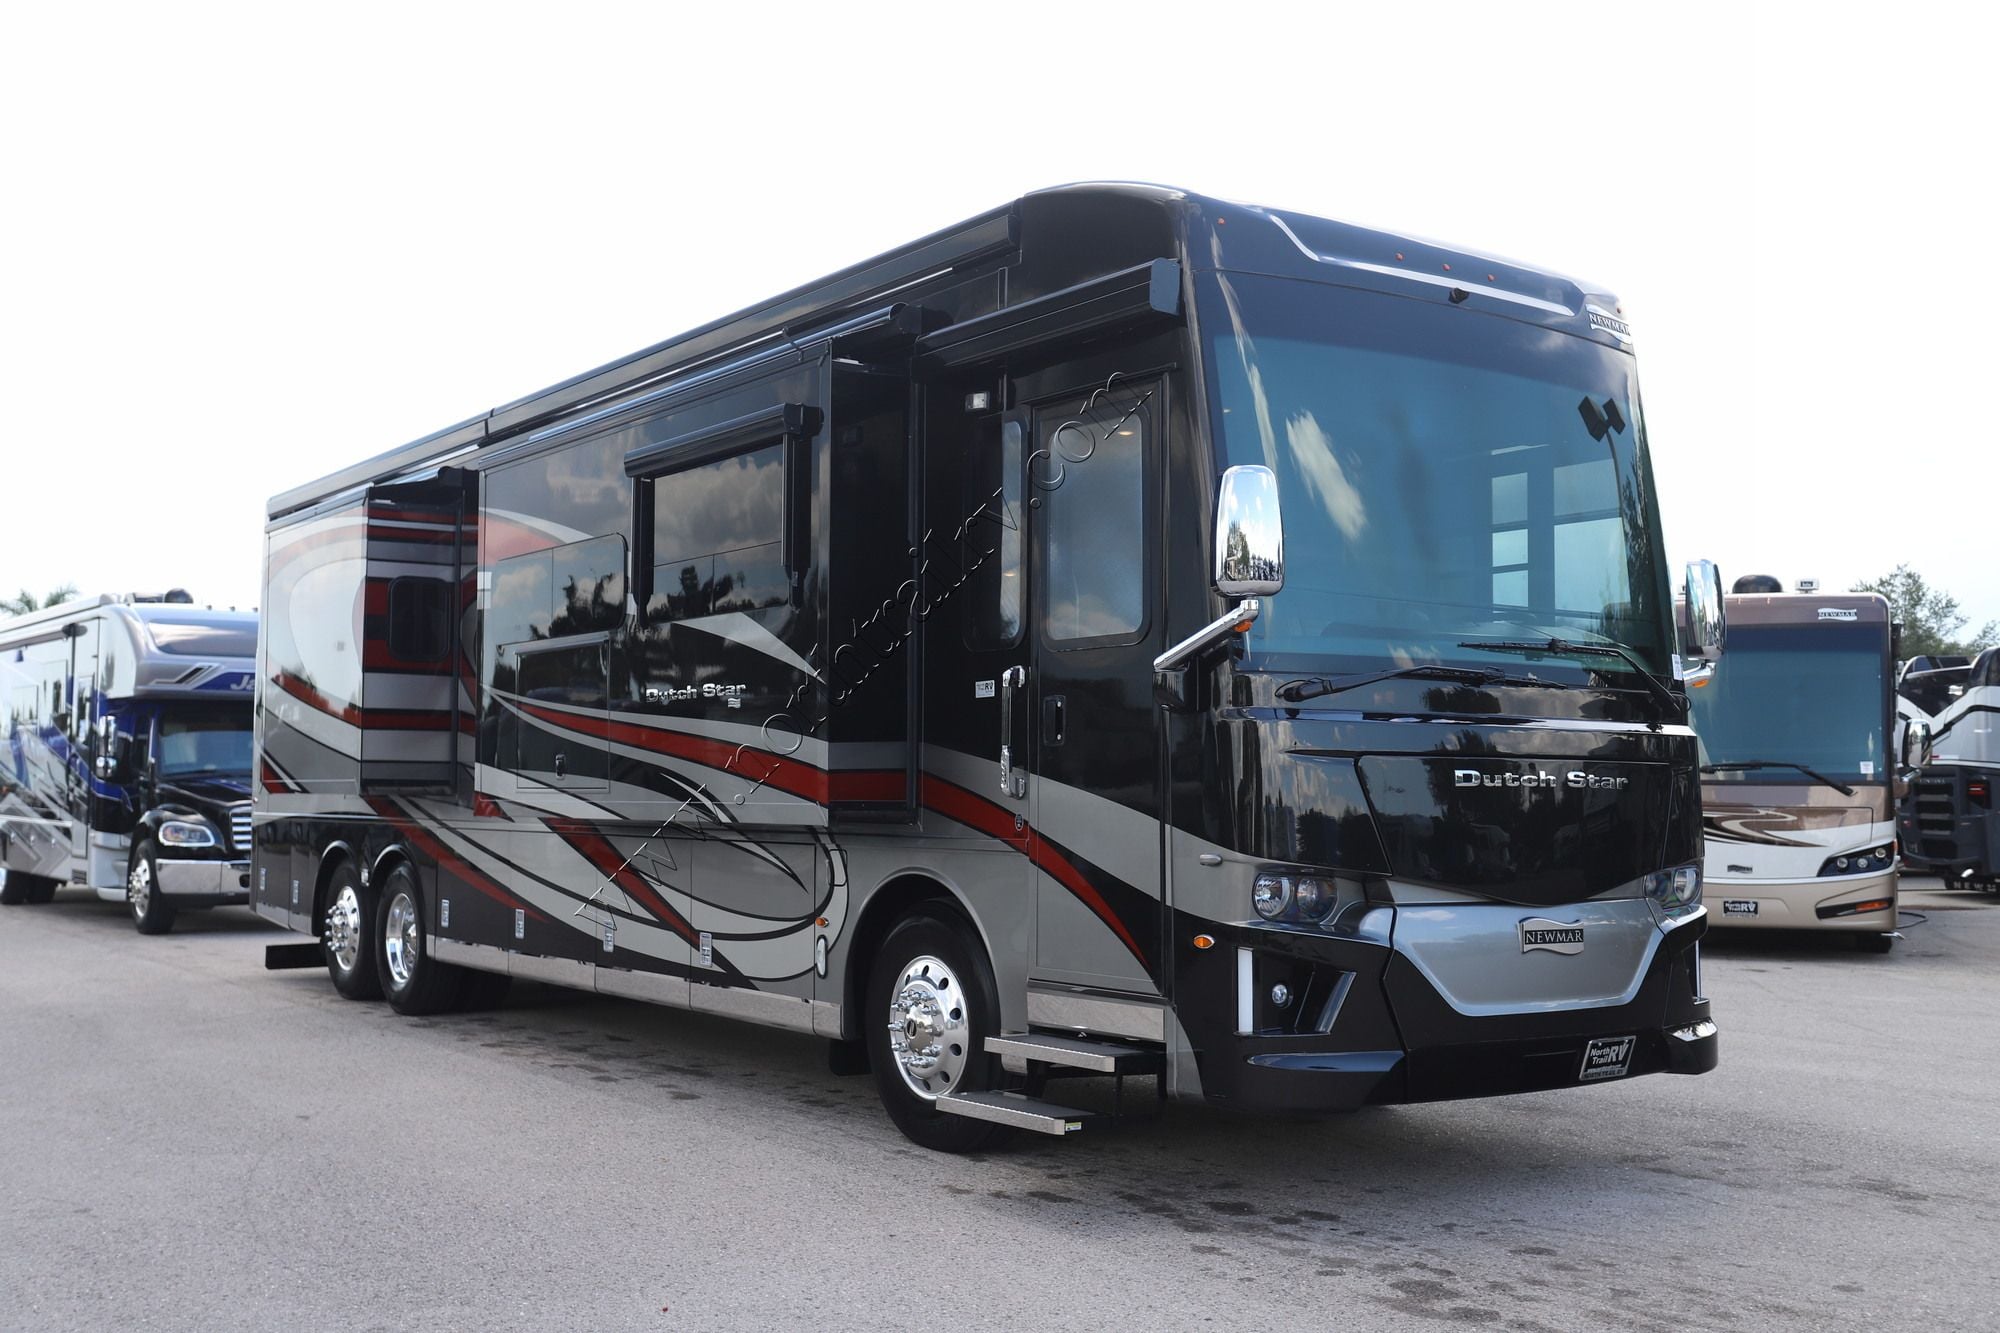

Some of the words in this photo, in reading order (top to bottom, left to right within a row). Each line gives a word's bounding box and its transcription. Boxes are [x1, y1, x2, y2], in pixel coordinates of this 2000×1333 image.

[1588, 312, 1630, 336] NEWMAR
[646, 684, 697, 702] Dutch
[702, 683, 746, 697] Star
[1454, 769, 1557, 787] Dutch
[1566, 770, 1628, 789] Star
[1741, 903, 1756, 911] RV
[1525, 931, 1583, 944] NEWMAR
[1590, 1047, 1610, 1056] North
[1607, 1044, 1629, 1062] RV
[1592, 1055, 1609, 1064] Trail
